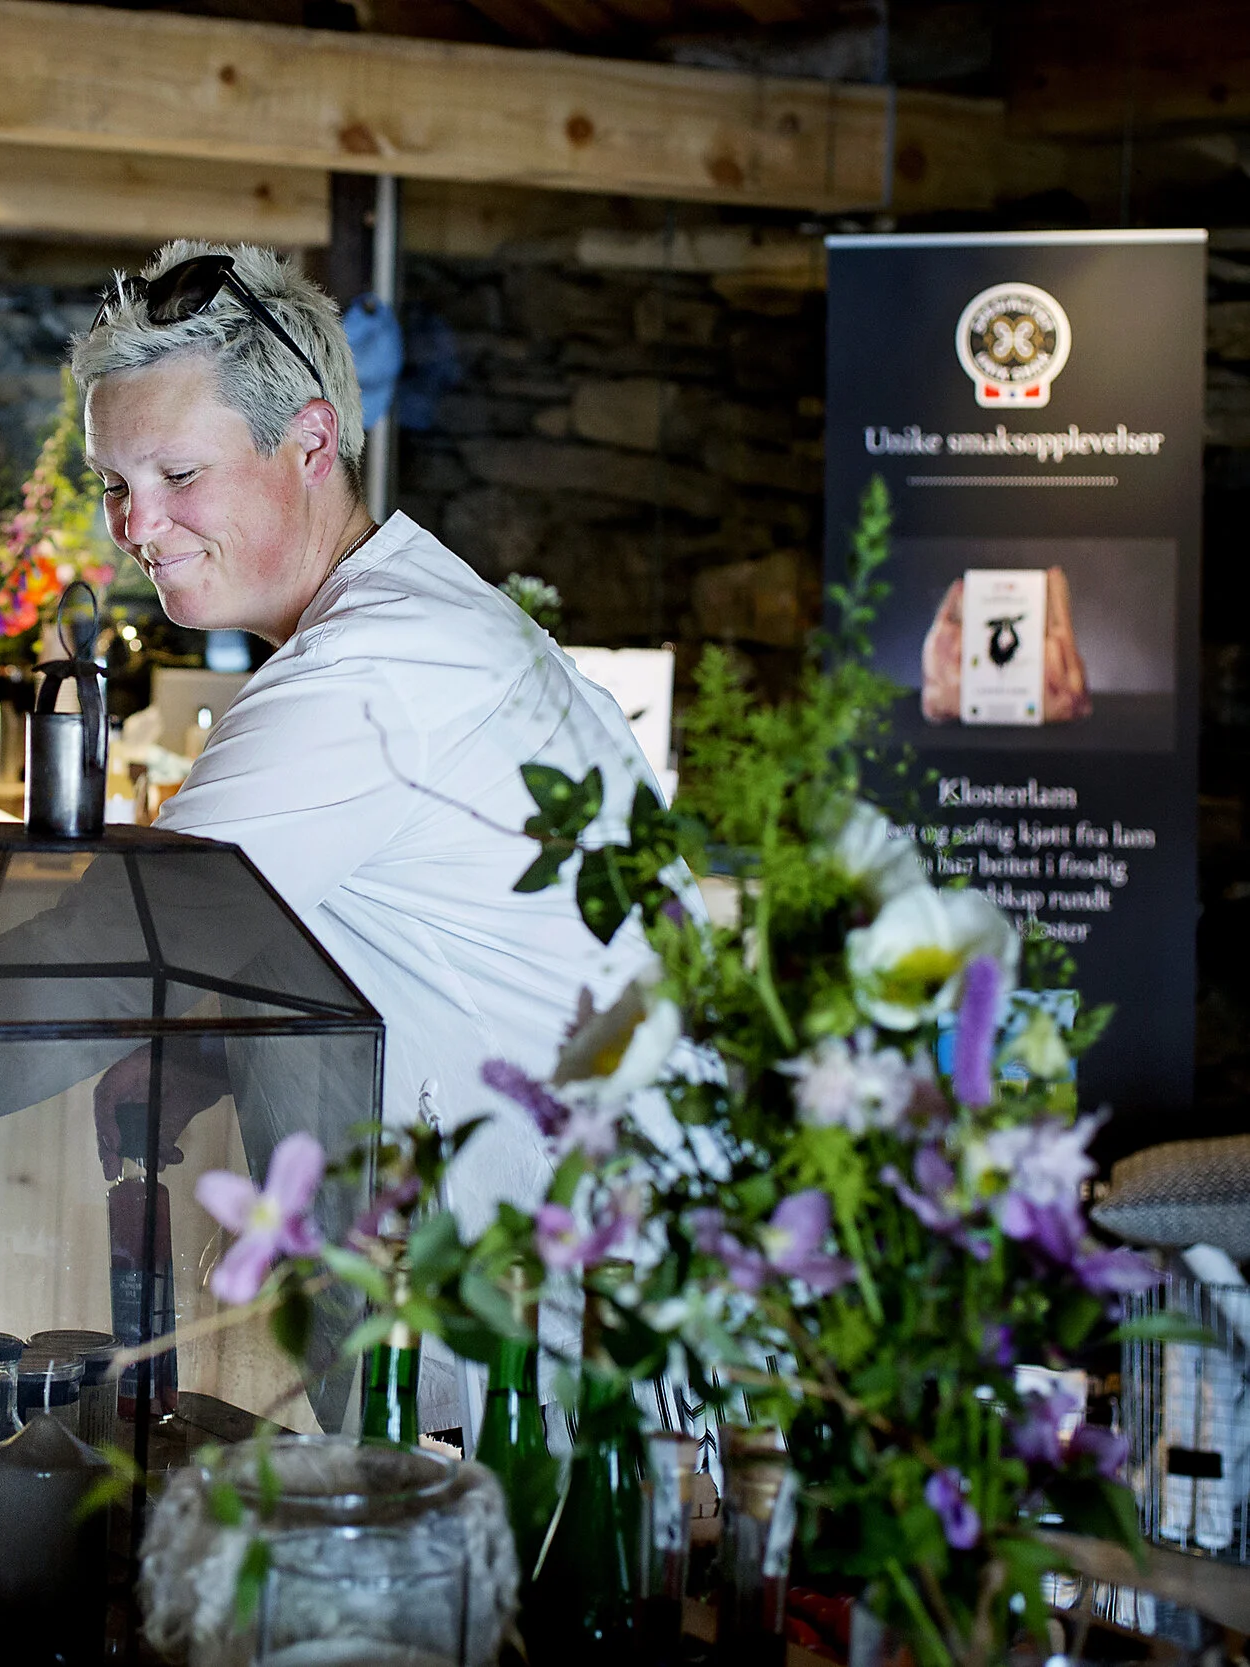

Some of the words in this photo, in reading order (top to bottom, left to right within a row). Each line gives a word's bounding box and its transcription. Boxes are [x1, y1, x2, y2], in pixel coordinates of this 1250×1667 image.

[865, 424, 943, 455] Unike
[946, 423, 1165, 463] smaksopplevelser
[939, 776, 1078, 808] Klosterlam
[1018, 818, 1071, 852] kjøtt
[1076, 819, 1109, 848] fra
[1112, 820, 1156, 849] lam
[978, 850, 1042, 878] beitet
[1045, 851, 1056, 879] i
[1059, 851, 1129, 888] frodig
[1048, 883, 1112, 912] rundt
